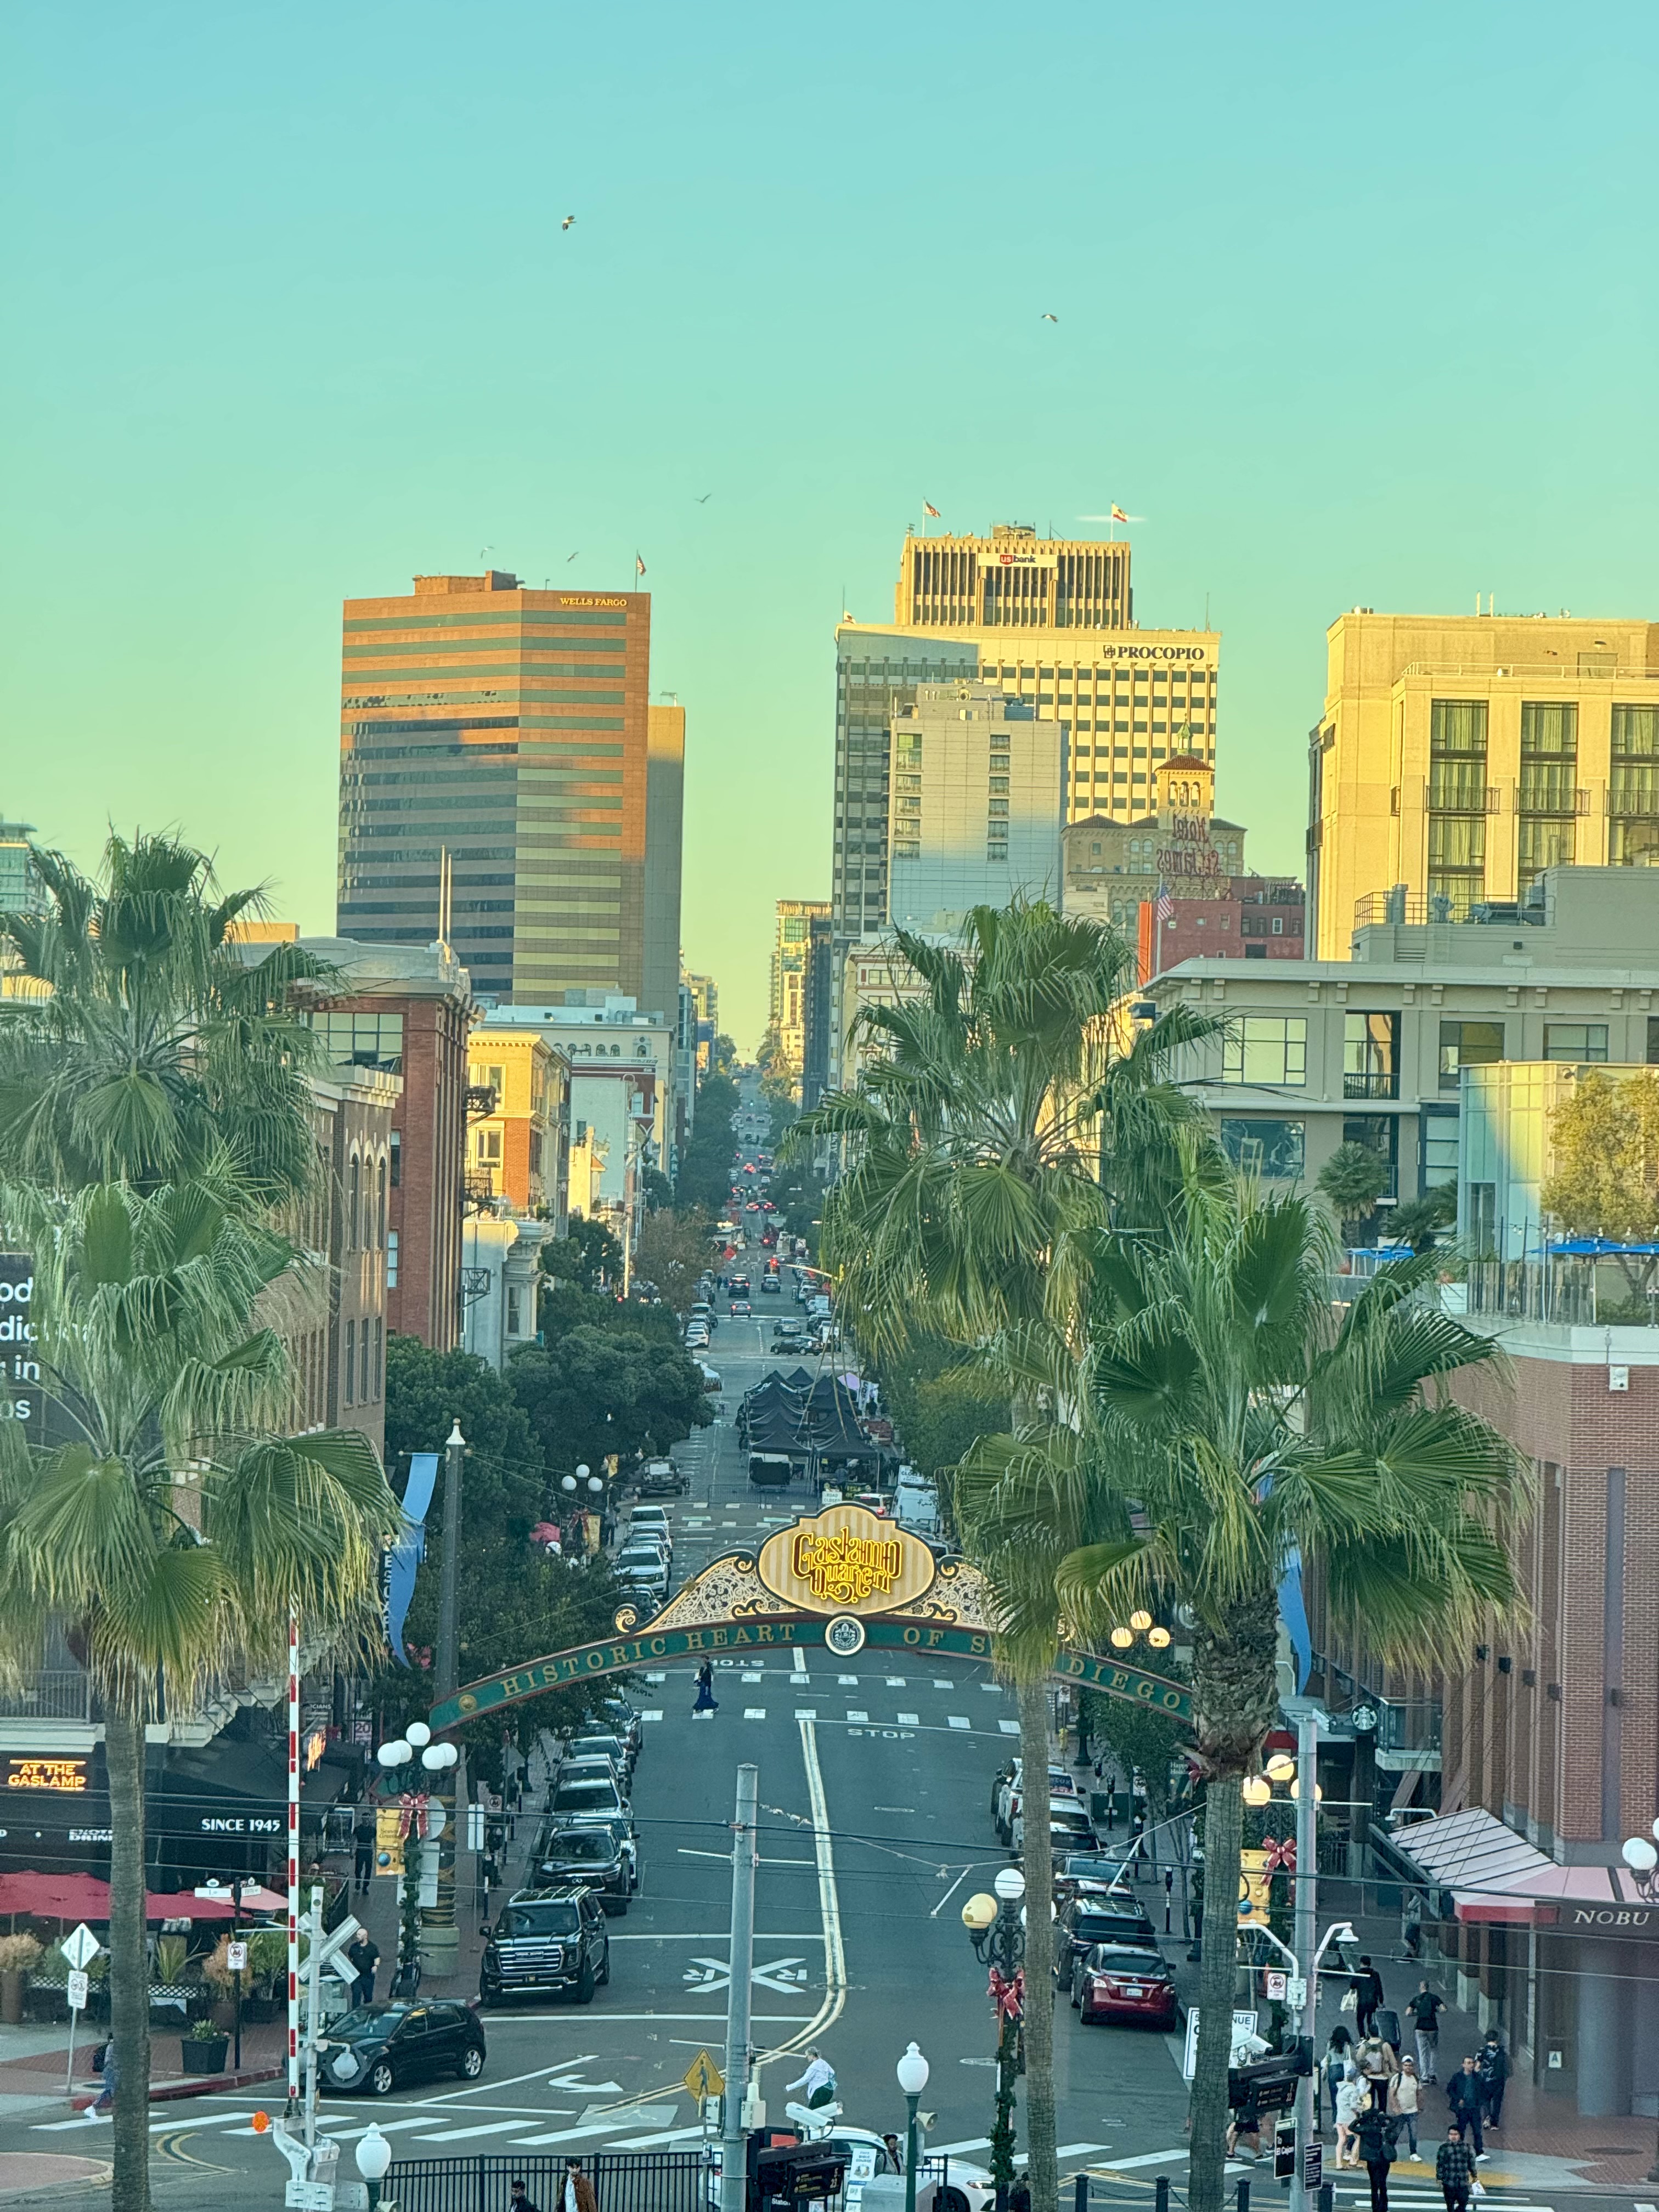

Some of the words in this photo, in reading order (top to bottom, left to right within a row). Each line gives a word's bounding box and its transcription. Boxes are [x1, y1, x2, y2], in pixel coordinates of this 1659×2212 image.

[560, 597, 593, 606] WELLS
[594, 598, 627, 607] FARGO
[1117, 646, 1205, 661] PROCOPIO
[792, 1526, 902, 1579] Gaslamp
[810, 1564, 890, 1604] Quarter
[500, 1638, 666, 1697] HISTORIC
[685, 1623, 795, 1650] HEART
[904, 1627, 944, 1647] OF
[1066, 1656, 1180, 1709] DIEGO
[847, 1728, 915, 1740] STOP
[20, 1763, 41, 1775] AT
[43, 1764, 76, 1776] THE
[8, 1774, 87, 1787] GASLAMP
[201, 1819, 245, 1831] SINCE
[249, 1819, 280, 1831] 1945
[1573, 1910, 1650, 1926] NOBU
[1233, 2016, 1251, 2025] NUE
